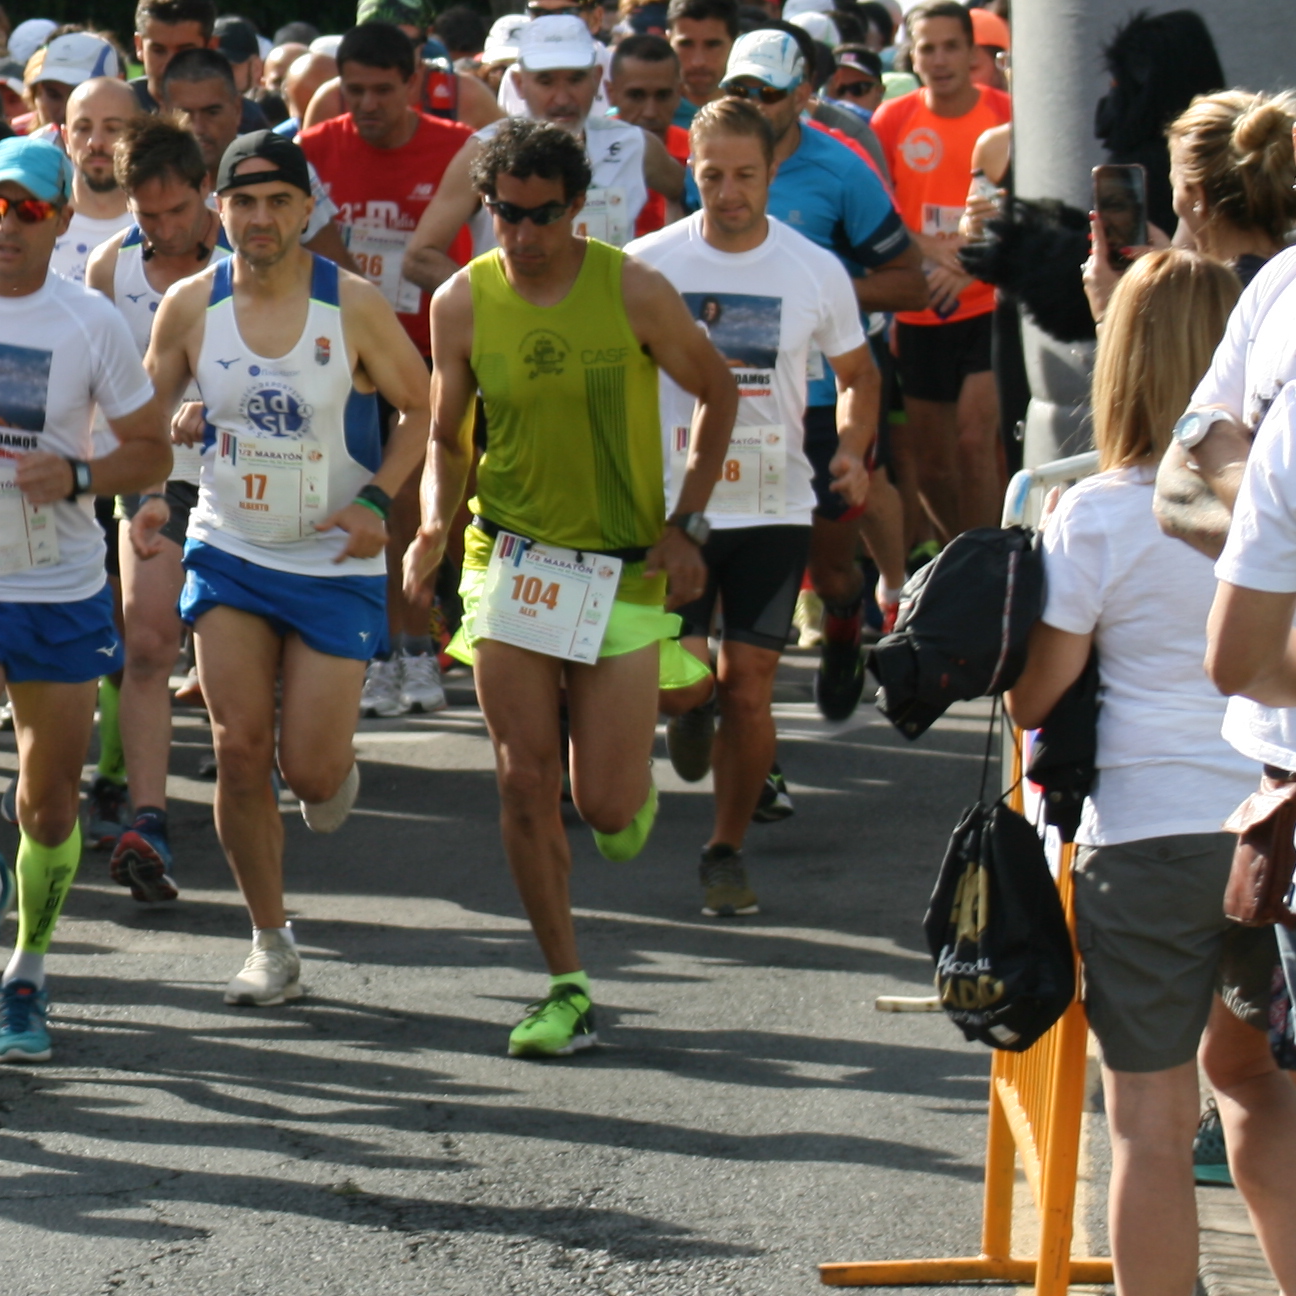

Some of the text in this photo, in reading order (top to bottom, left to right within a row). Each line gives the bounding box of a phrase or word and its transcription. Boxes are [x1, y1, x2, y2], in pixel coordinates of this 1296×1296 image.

[254, 449, 303, 461] MARATÓN
[241, 473, 267, 500] 17
[543, 557, 593, 574] MARATÓN
[511, 574, 560, 610] 104
